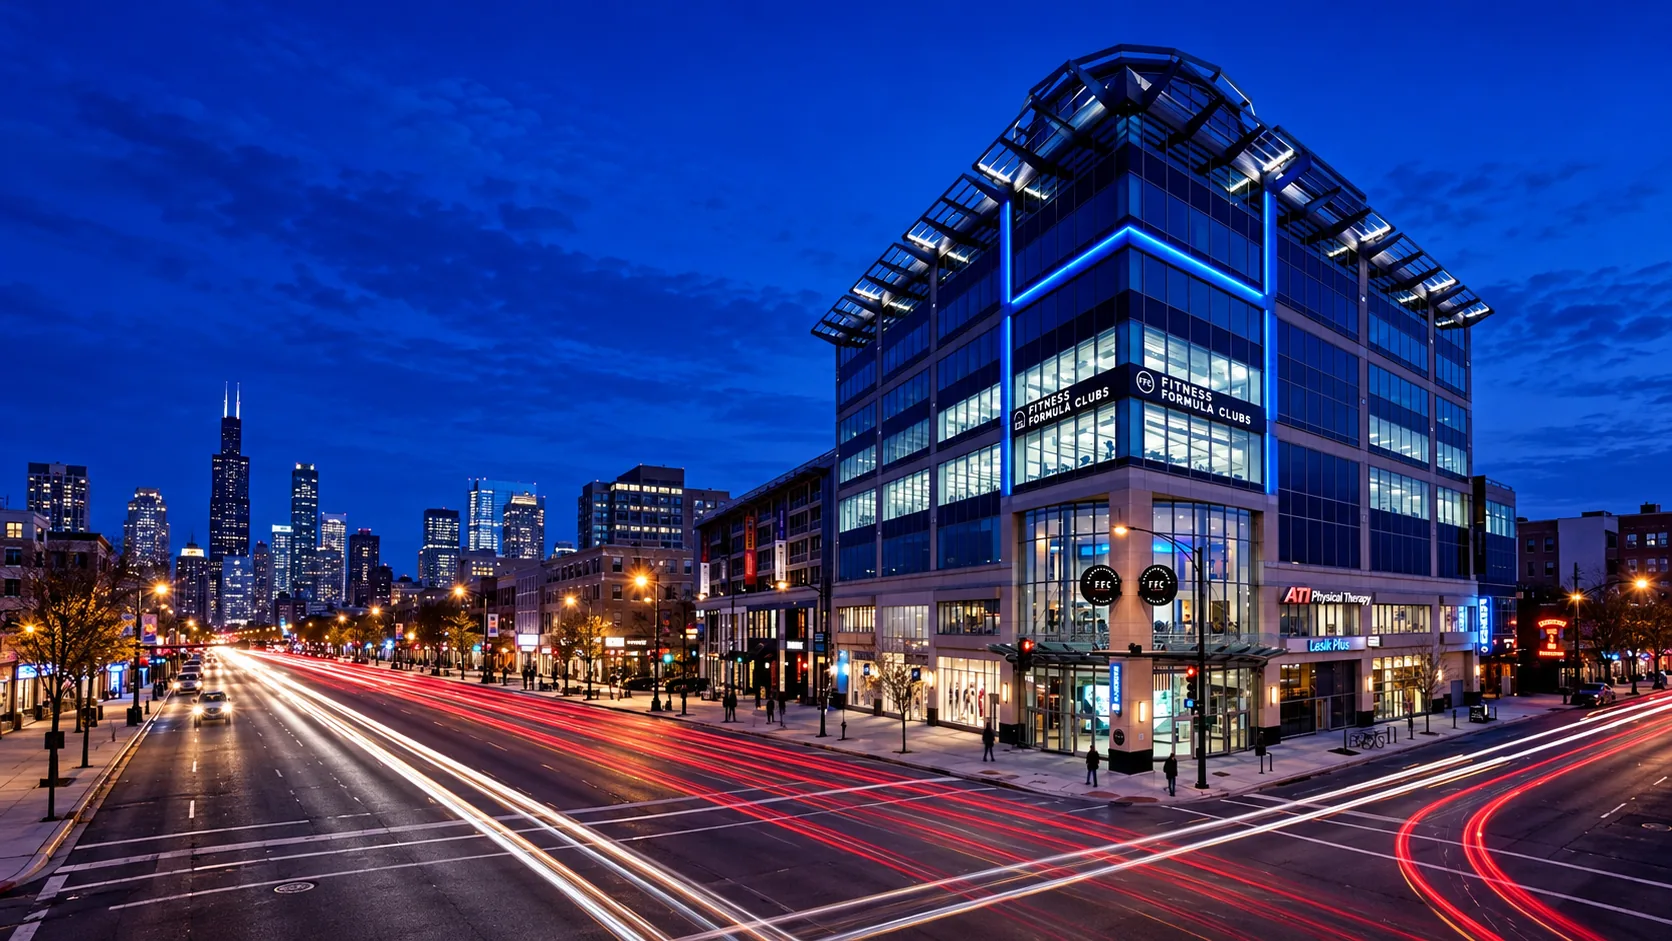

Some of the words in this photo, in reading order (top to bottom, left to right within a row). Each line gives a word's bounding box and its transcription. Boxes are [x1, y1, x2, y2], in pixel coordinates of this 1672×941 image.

[1161, 377, 1212, 402] FITNESS
[1028, 390, 1070, 416] FITNESS
[1028, 402, 1071, 427] FORMULA
[1075, 386, 1109, 408] CLUBS
[1161, 389, 1214, 414] FORMULA
[1218, 406, 1251, 425] CLUBS
[1094, 580, 1112, 589] FFC
[1148, 580, 1165, 589] FFC
[1284, 586, 1311, 604] ATI
[1311, 590, 1343, 605] Physical
[1344, 592, 1372, 606] Therapy
[1332, 638, 1350, 651] Plus
